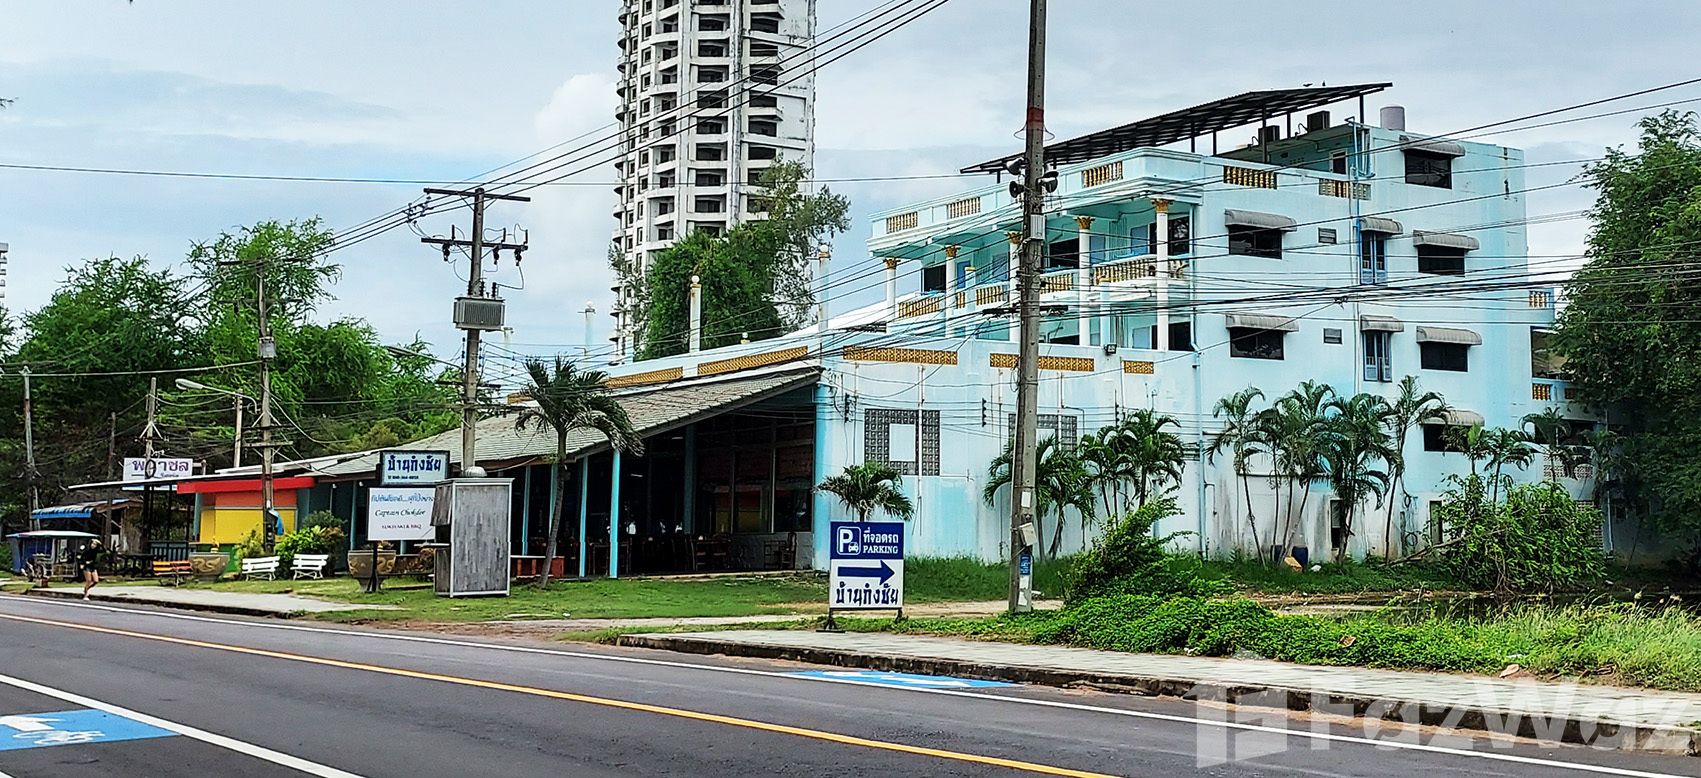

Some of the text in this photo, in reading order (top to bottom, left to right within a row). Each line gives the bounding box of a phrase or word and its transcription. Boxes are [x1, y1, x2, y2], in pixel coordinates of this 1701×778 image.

[863, 526, 899, 543] ที่จอดรถ
[862, 545, 899, 554] PARKING
